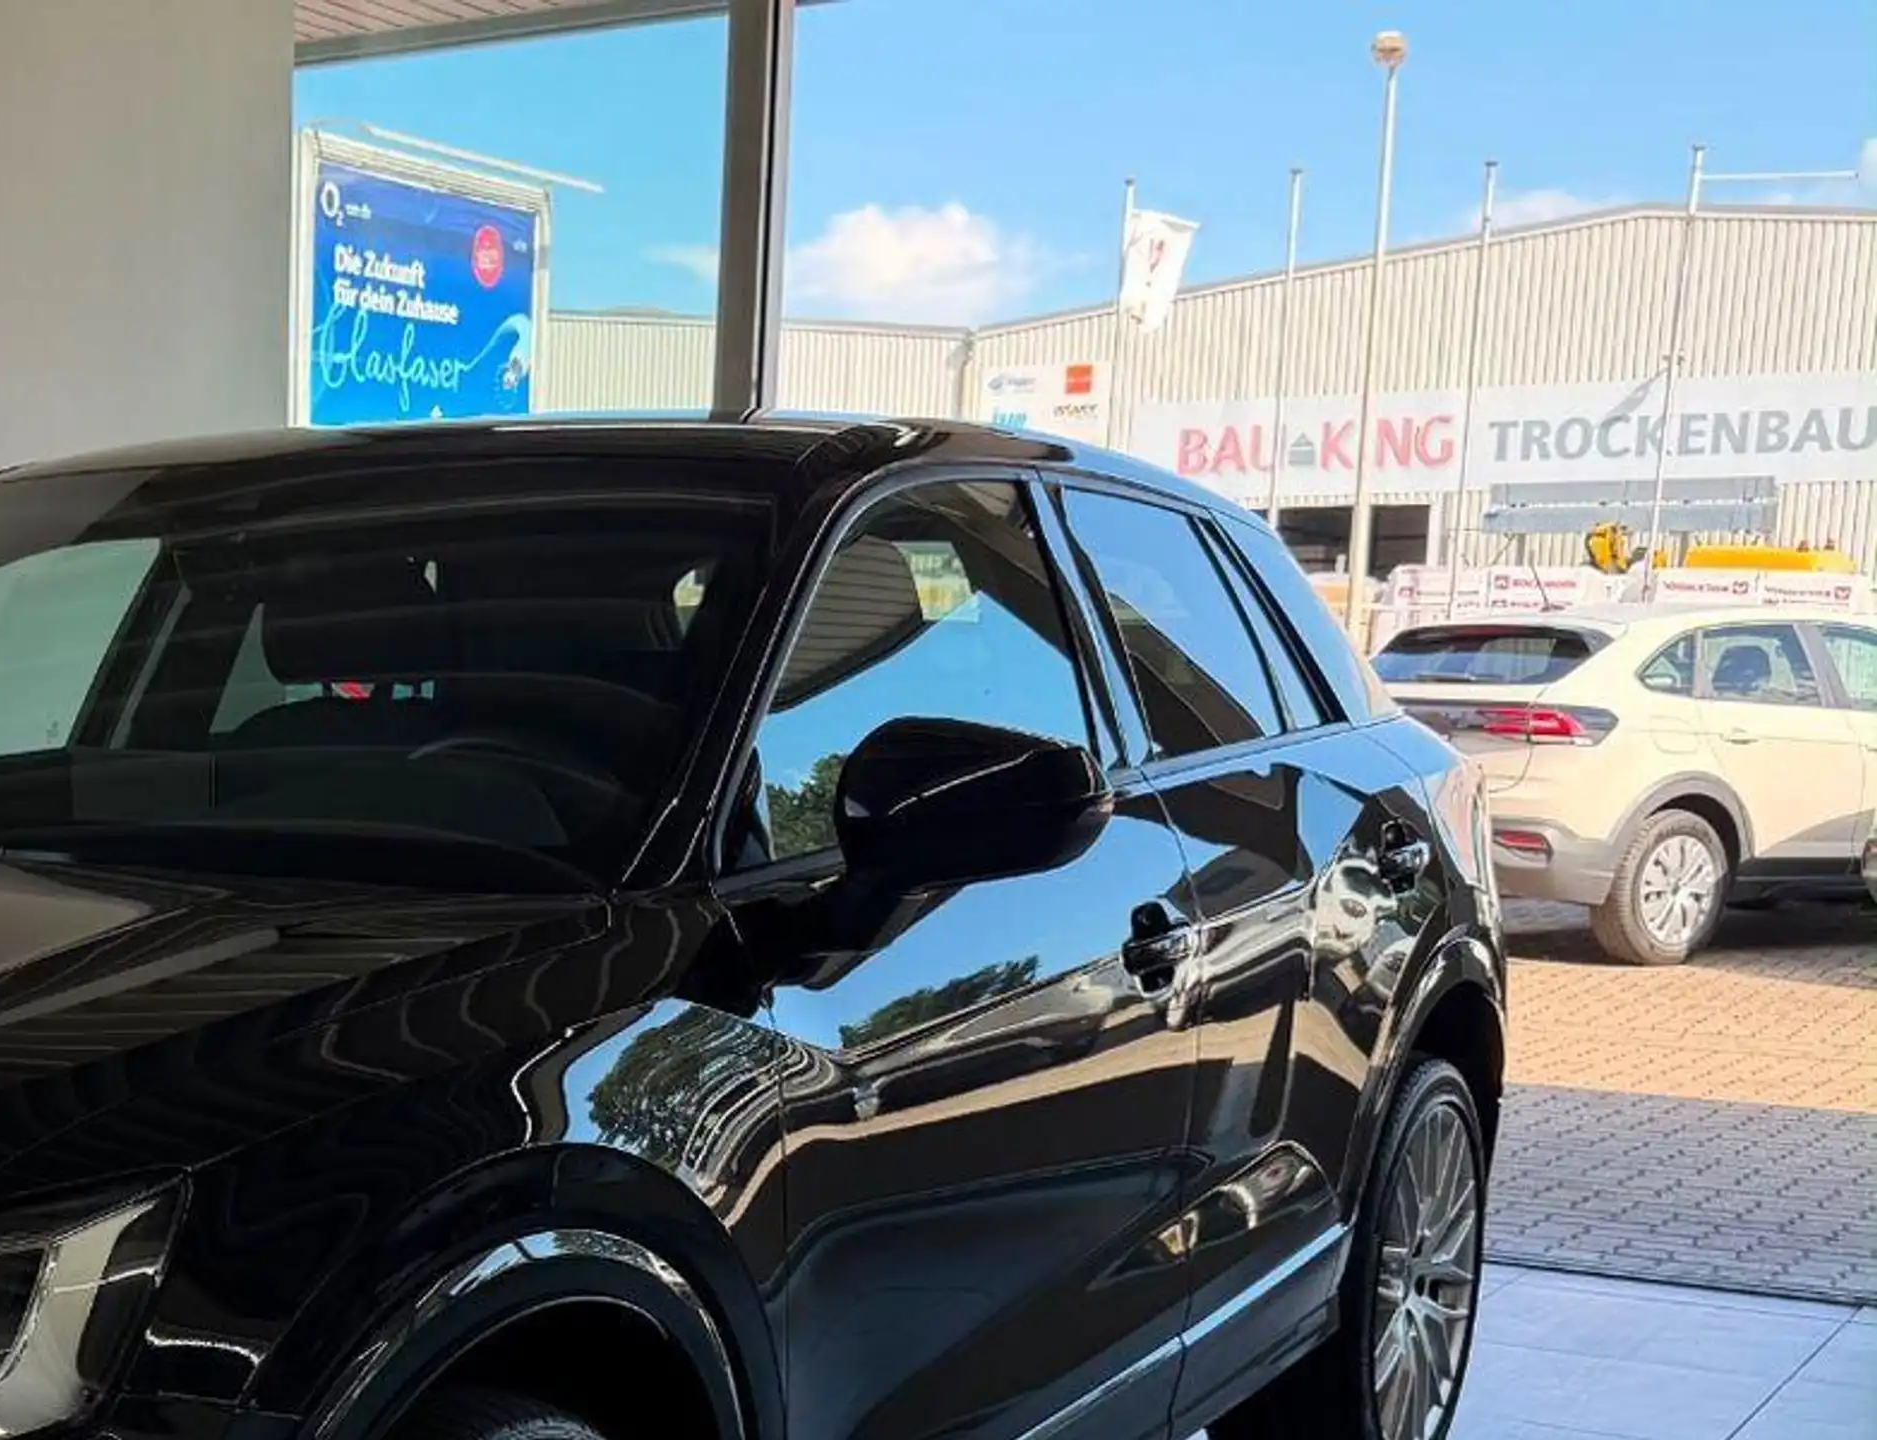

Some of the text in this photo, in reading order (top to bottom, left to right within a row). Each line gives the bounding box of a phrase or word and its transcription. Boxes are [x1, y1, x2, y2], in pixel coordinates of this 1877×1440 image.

[334, 243, 426, 289] Die Zukunft
[359, 284, 395, 315] dein
[396, 289, 460, 325] Zuhause
[311, 300, 473, 412] Glasfaser
[1178, 415, 1455, 475] BAU KNG
[1488, 405, 1877, 462] TROCKENBAU
